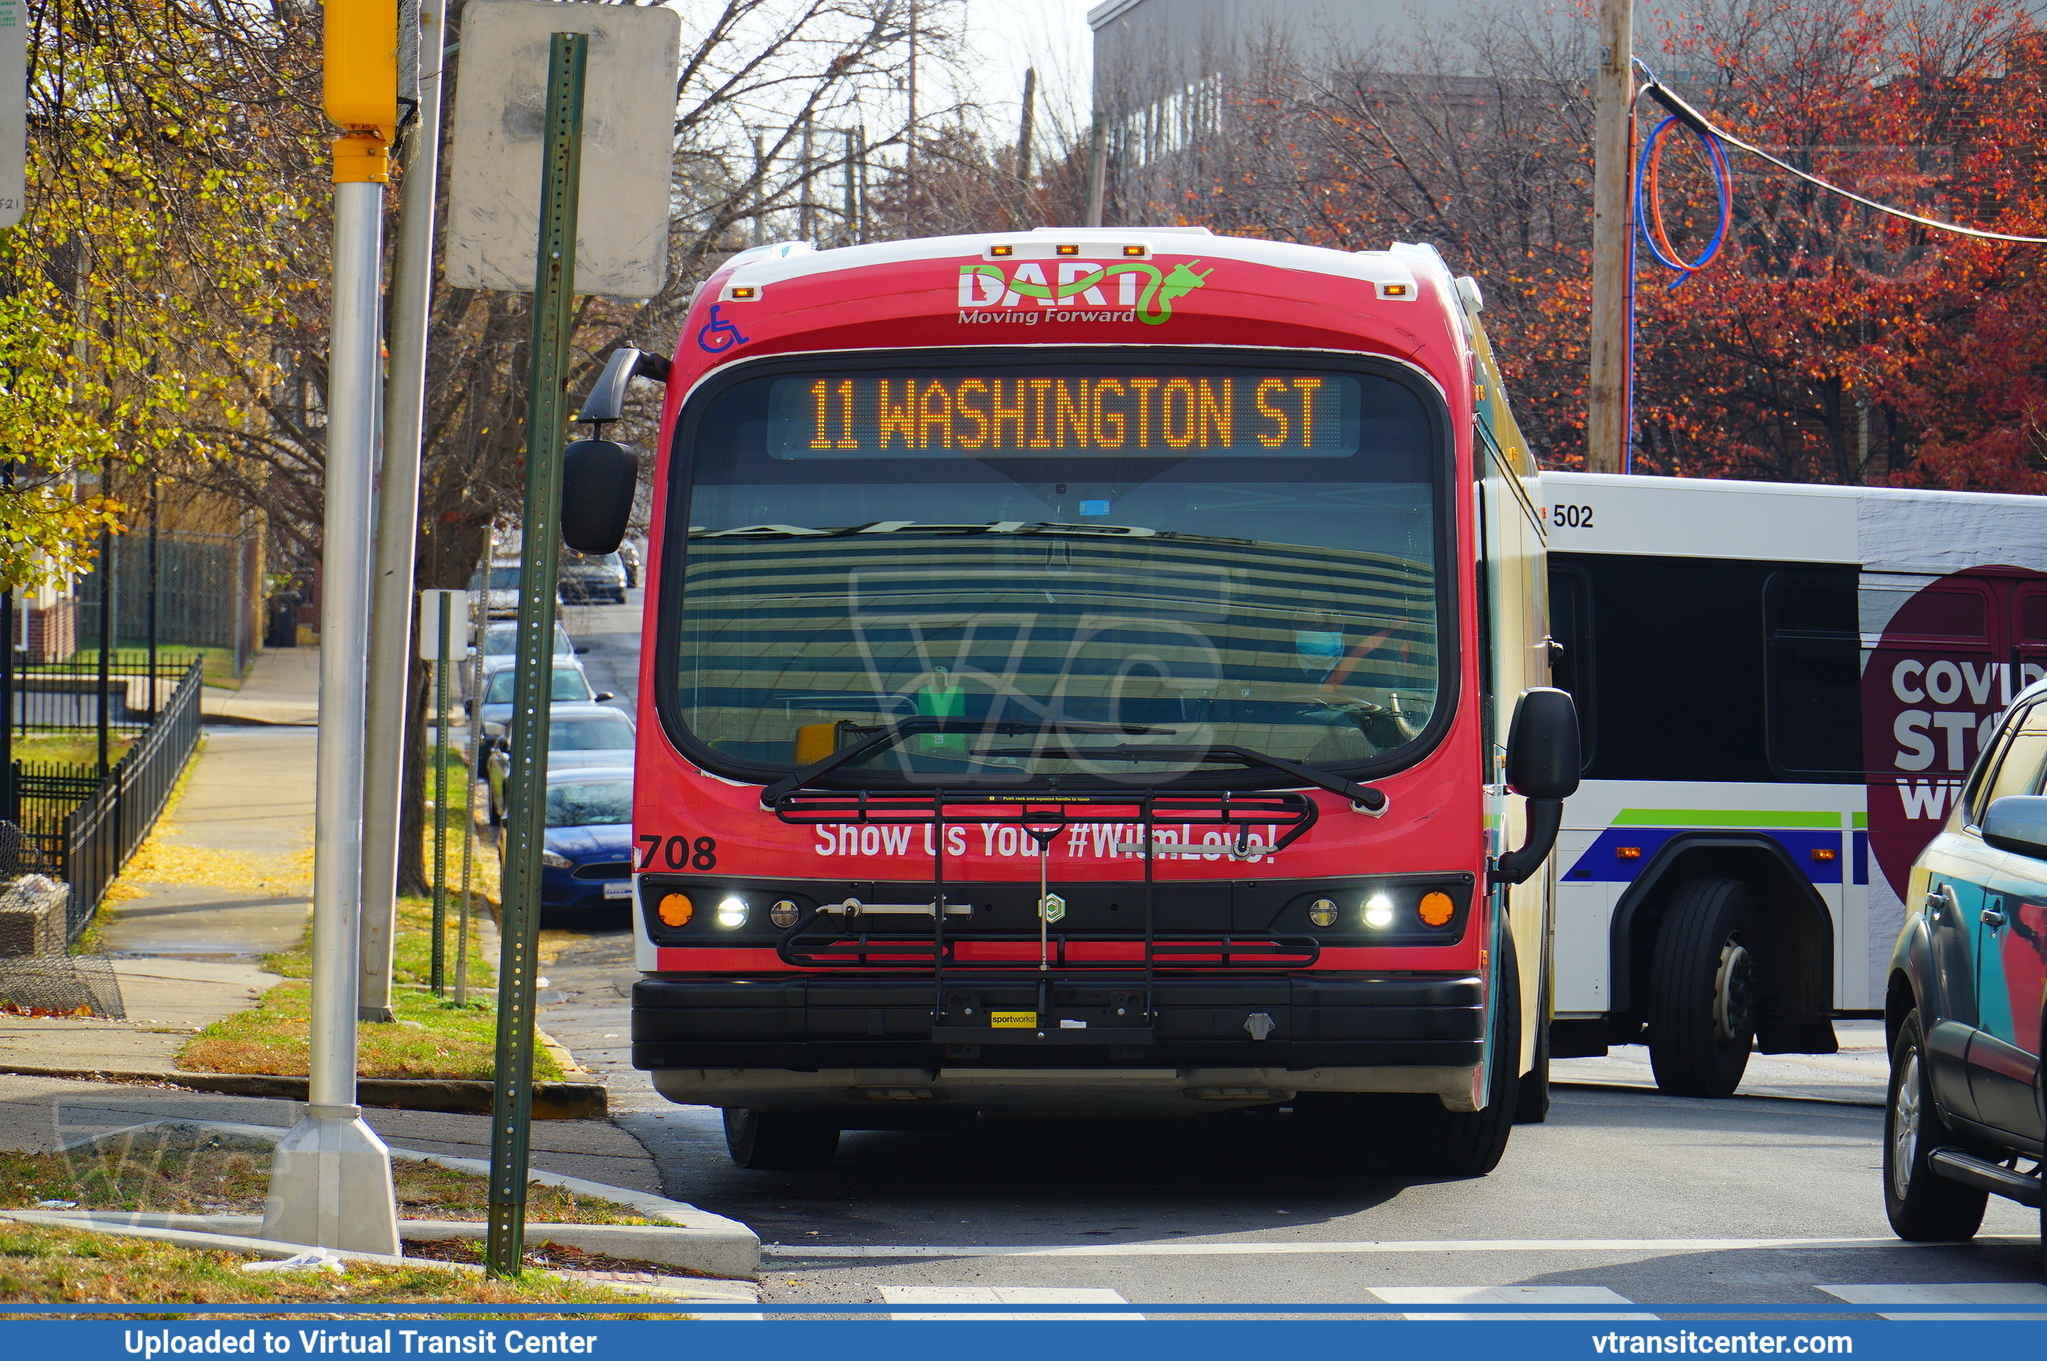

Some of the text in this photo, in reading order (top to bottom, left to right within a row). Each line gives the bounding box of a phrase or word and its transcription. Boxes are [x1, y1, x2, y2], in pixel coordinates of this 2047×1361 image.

[958, 308, 1136, 326] Moving Forward
[809, 379, 1322, 449] 11 WASHINGTON ST
[1553, 504, 1594, 528] 502
[639, 834, 717, 871] 708
[815, 824, 912, 856] Show
[924, 824, 967, 857] Us
[992, 1015, 1036, 1024] sportworks
